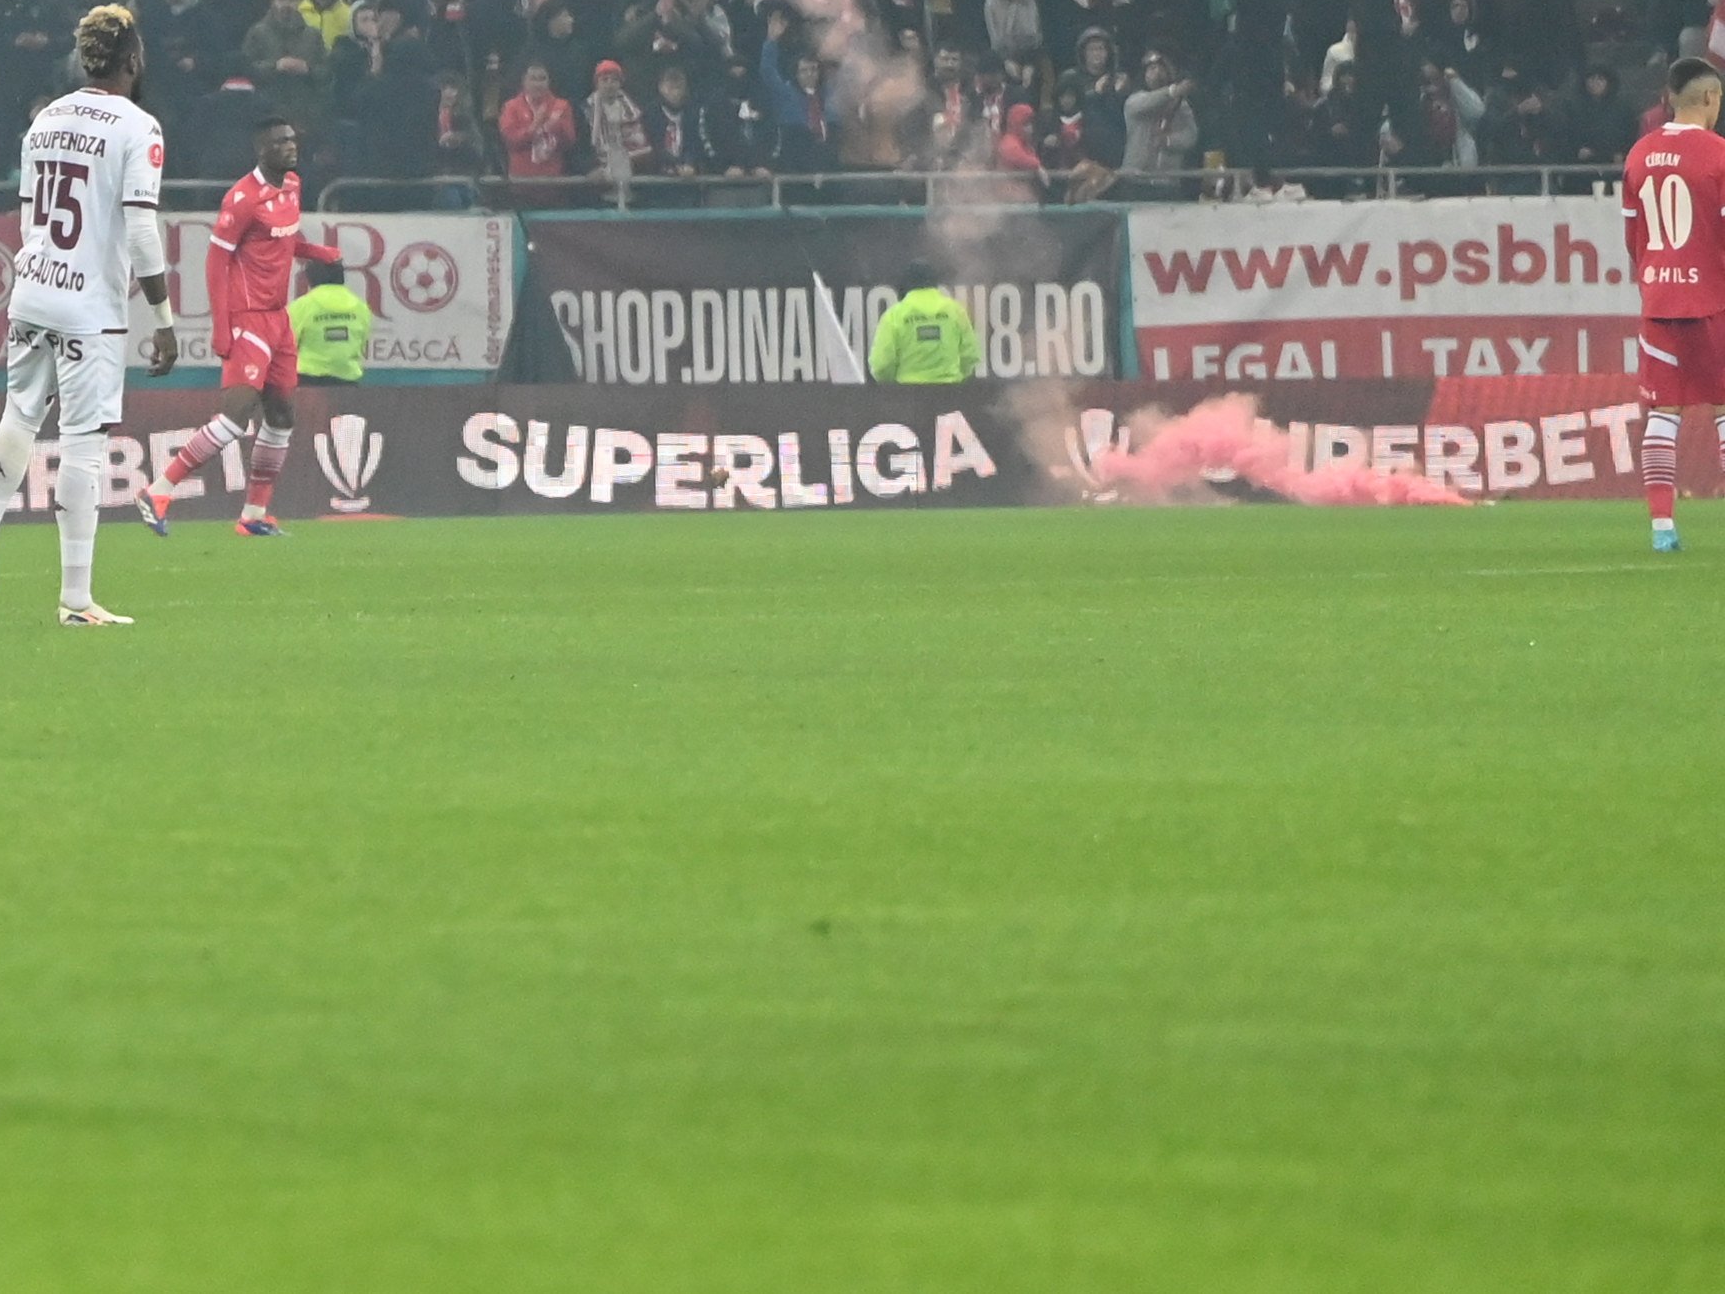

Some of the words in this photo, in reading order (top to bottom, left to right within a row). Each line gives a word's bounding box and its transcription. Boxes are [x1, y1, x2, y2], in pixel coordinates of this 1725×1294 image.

[29, 130, 106, 158] BOUPENDZA
[1637, 174, 1694, 252] 10
[1422, 336, 1551, 378] TAX
[455, 410, 997, 511] SUPERLIGA
